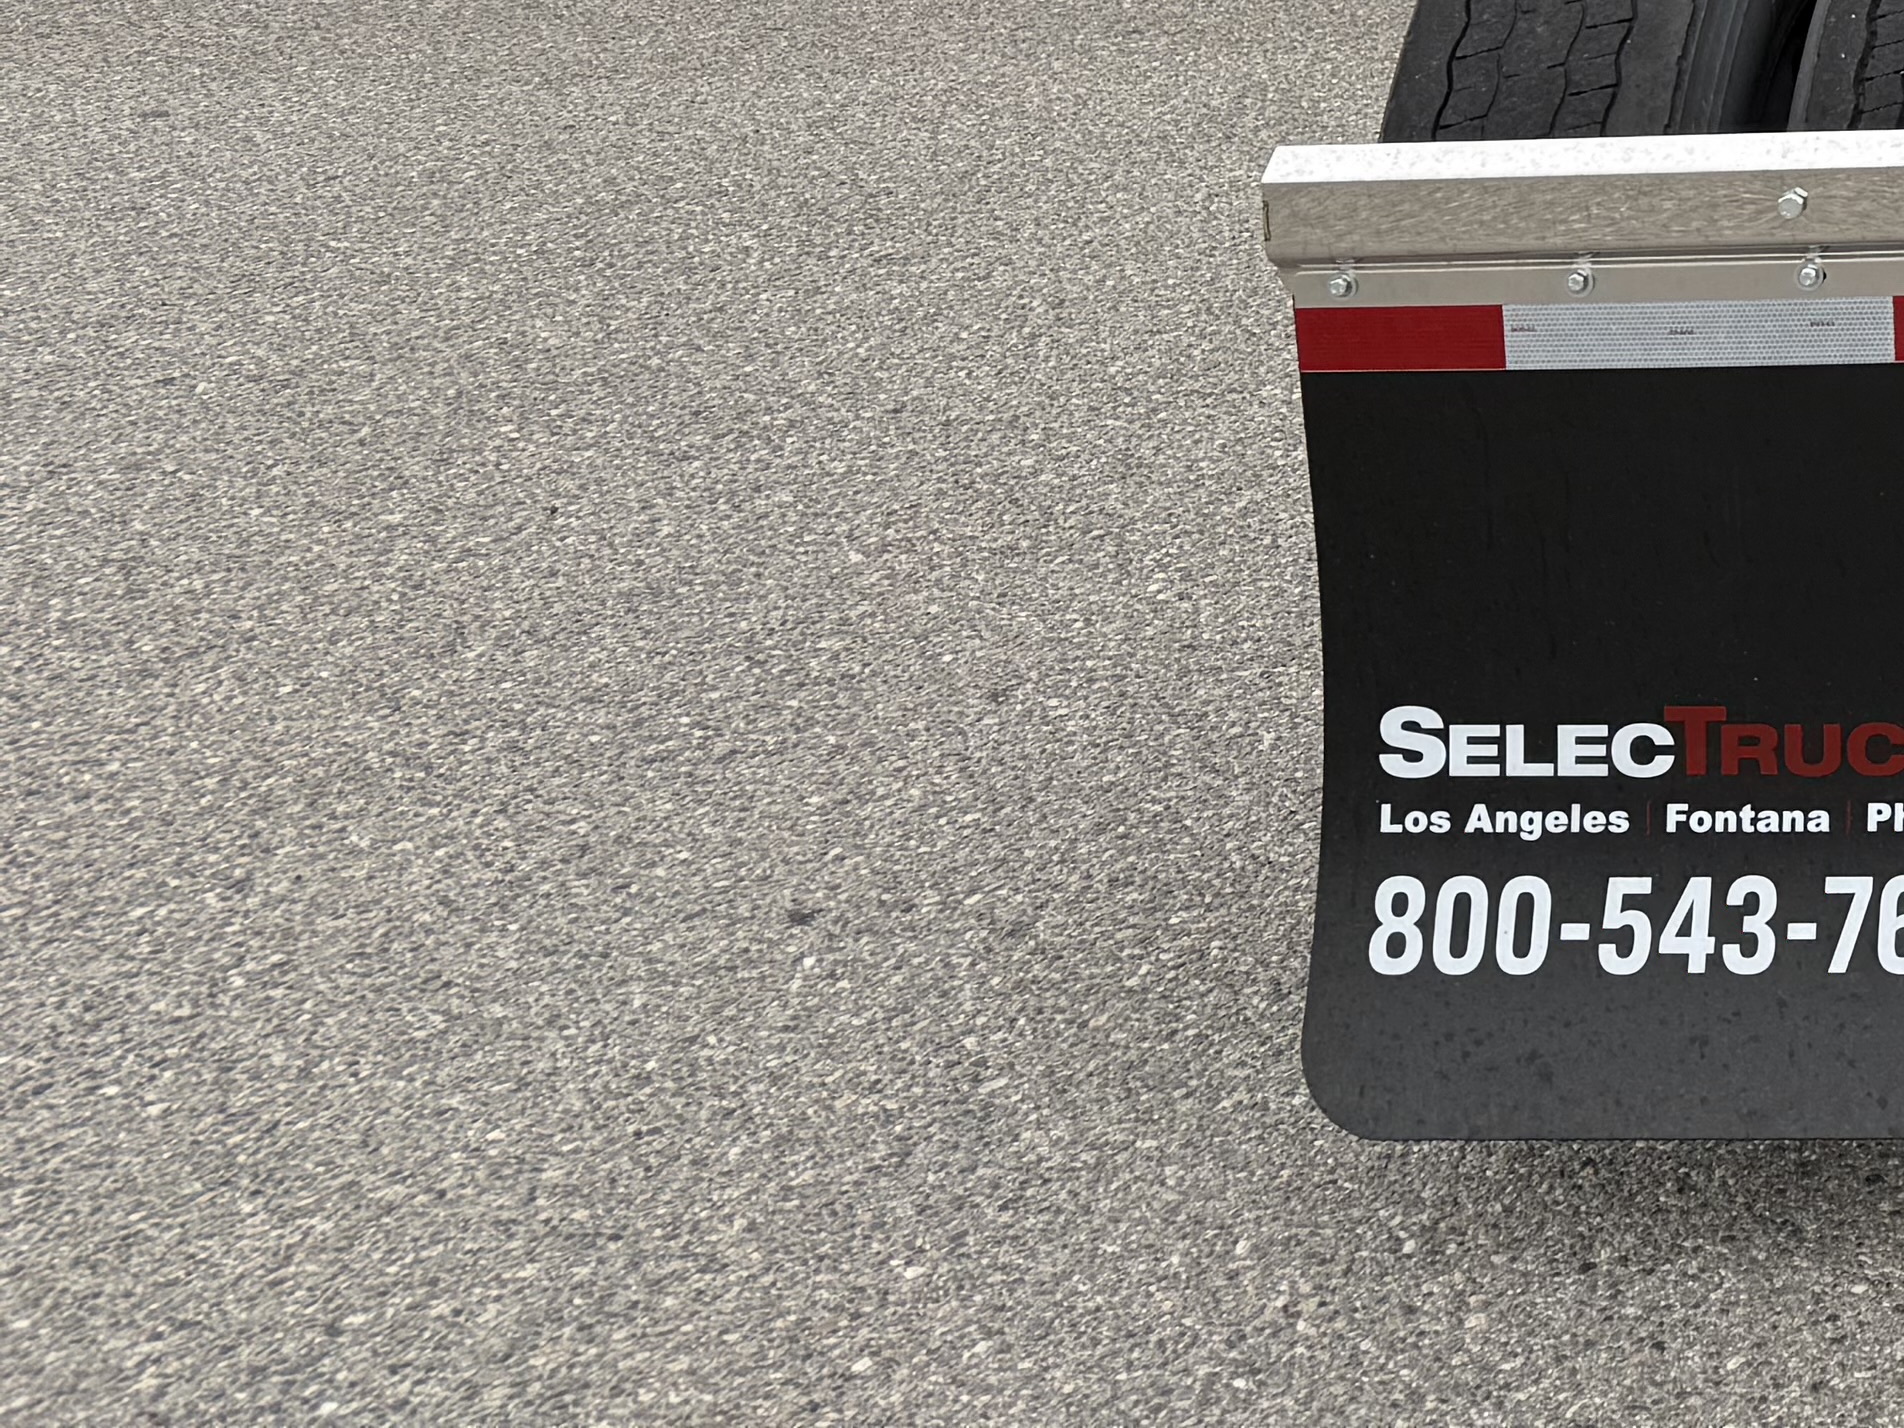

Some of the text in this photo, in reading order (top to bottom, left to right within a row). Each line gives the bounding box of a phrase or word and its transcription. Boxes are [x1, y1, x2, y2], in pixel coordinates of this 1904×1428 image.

[1379, 803, 1452, 834] Los
[1464, 803, 1630, 842] Angeles
[1665, 803, 1830, 834] Fontana
